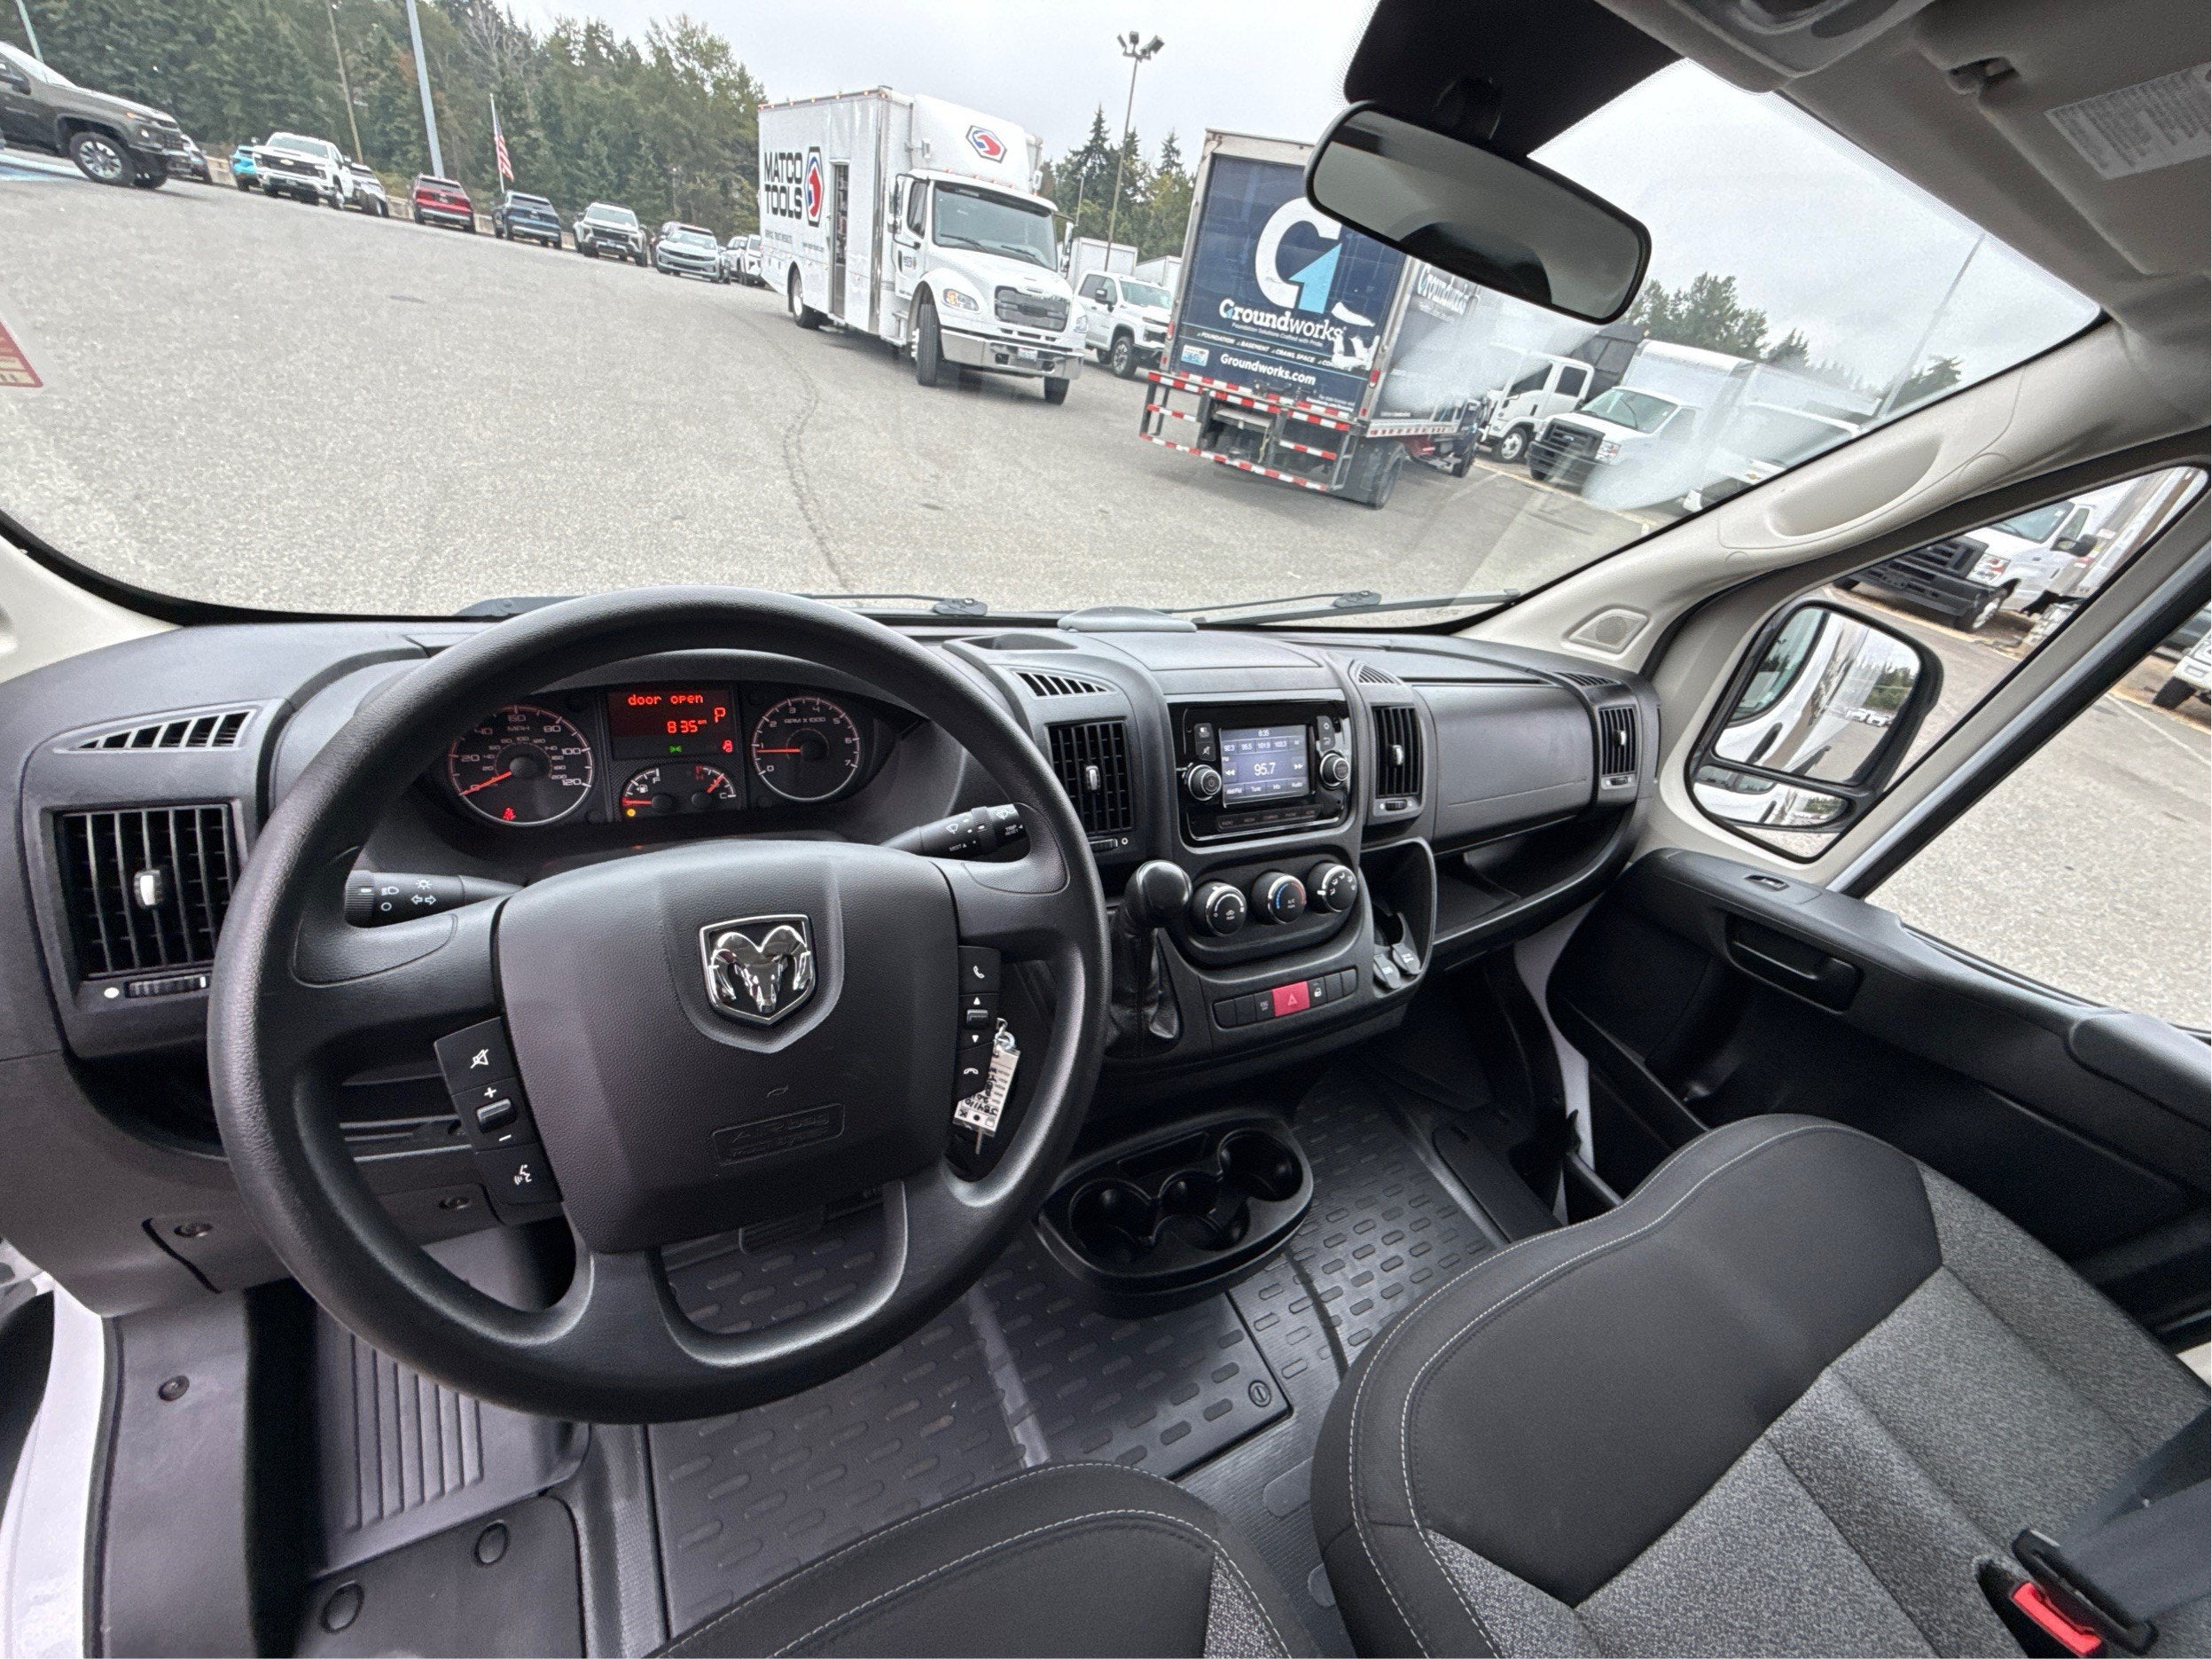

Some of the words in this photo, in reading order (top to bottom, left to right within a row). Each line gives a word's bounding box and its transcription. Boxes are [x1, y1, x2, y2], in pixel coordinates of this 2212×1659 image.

[764, 152, 802, 184] MATCO
[764, 184, 802, 220] TOOLS
[1219, 299, 1344, 341] Groundworks
[1201, 332, 1235, 345] FOUNDATION
[1240, 340, 1270, 352] BASEMENT
[1275, 348, 1296, 360] CRAWL
[1297, 353, 1317, 364] SPACE
[1220, 353, 1317, 386] Groundworks.com
[628, 694, 662, 706] door
[670, 694, 704, 705] open
[714, 707, 726, 723] P
[1254, 762, 1276, 776] 95.7
